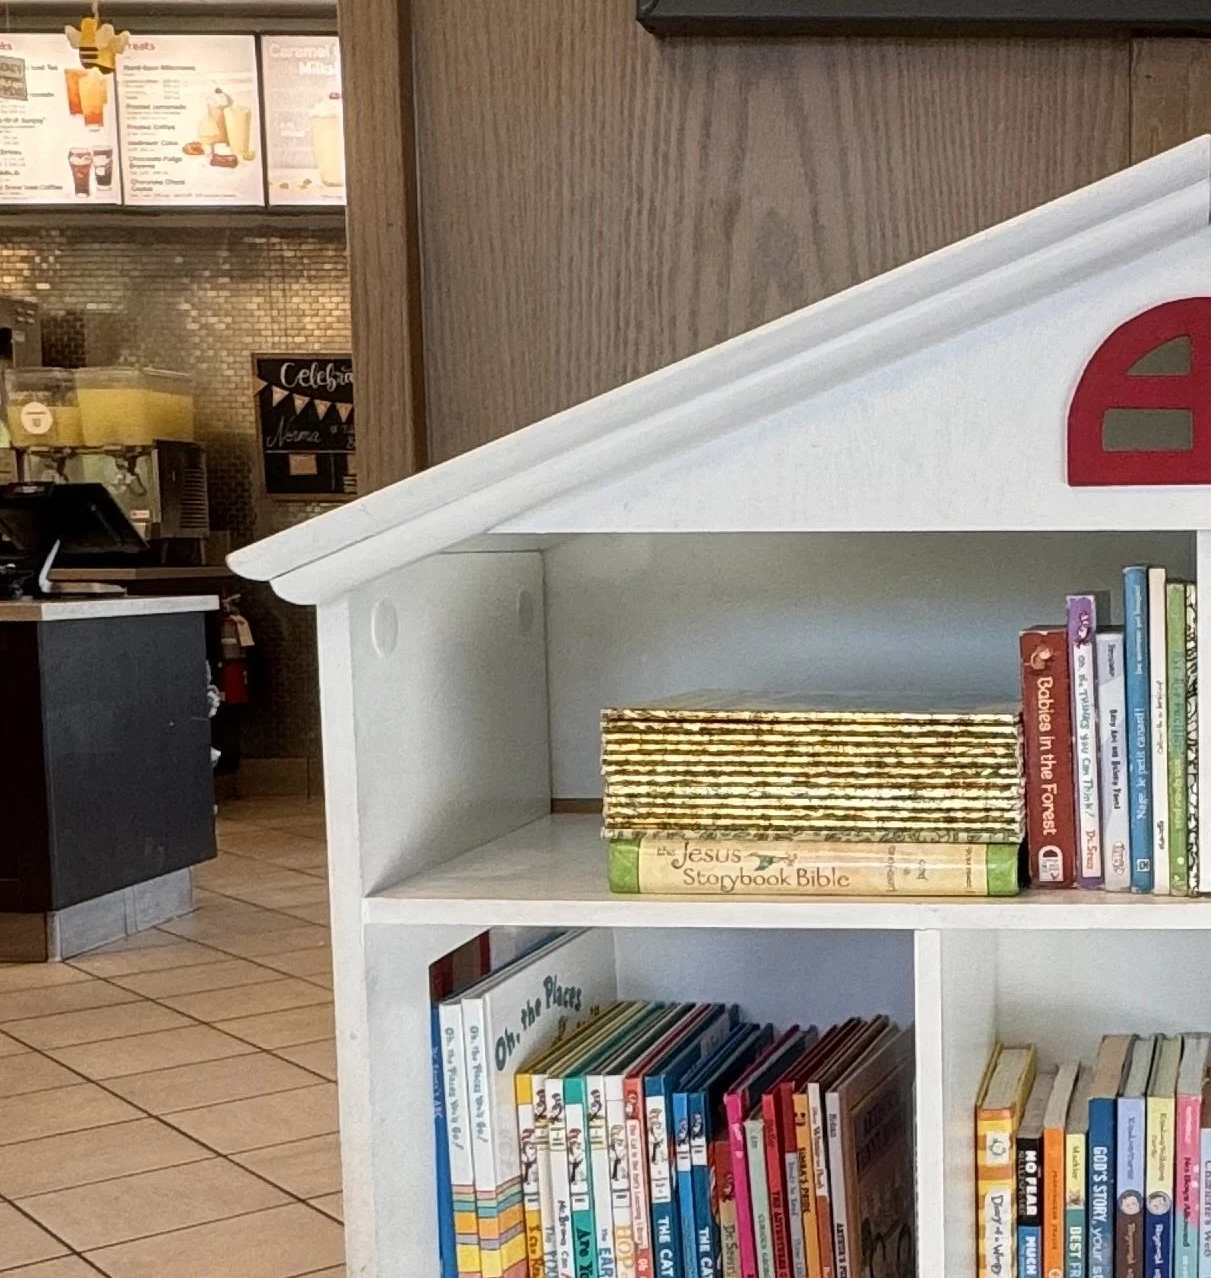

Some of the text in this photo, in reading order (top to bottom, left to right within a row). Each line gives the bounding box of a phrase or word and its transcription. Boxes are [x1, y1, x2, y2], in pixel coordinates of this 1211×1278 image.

[1037, 677, 1057, 835] Babies the Forest
[672, 842, 741, 868] Jesus
[683, 867, 850, 893] Storybook Bible
[542, 974, 583, 1013] Places
[1093, 1146, 1107, 1182] GOD'S
[1025, 1150, 1037, 1215] NO FEAR
[1182, 1172, 1191, 1199] Boys
[1092, 1185, 1108, 1224] STORY,
[576, 1228, 592, 1258] Are
[658, 1216, 669, 1244] THE
[699, 1227, 711, 1252] THE
[1069, 1226, 1081, 1259] BEST
[1090, 1227, 1104, 1262] your
[599, 1247, 614, 1278] EAR
[660, 1249, 673, 1277] CAT
[1026, 1236, 1036, 1274] MUCH
